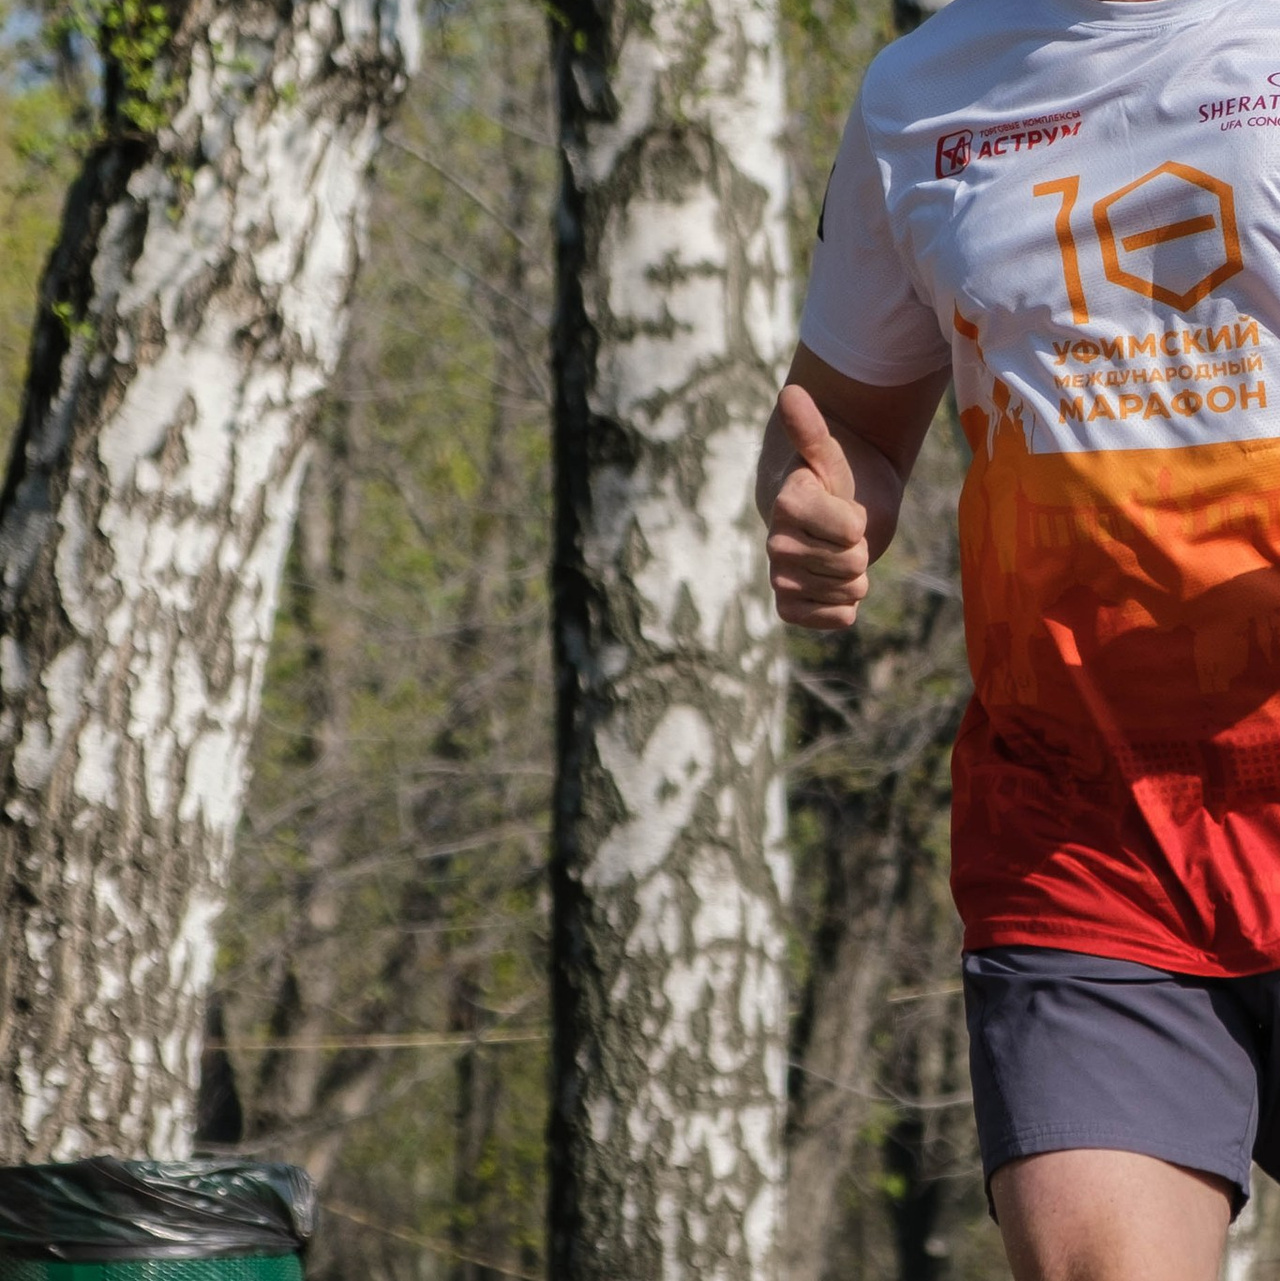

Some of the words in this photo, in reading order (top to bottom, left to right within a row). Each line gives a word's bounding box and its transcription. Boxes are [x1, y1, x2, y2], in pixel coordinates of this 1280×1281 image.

[977, 122, 1082, 159] АСТРУМ
[980, 121, 1020, 137] ТОРГОВЫЕ
[1022, 110, 1081, 129] КОМПЛЕКСЫ
[1220, 119, 1242, 131] UFA
[1051, 315, 1260, 366] УФИМСКИЙ
[1053, 352, 1263, 390] МЕЖДУНАРОДНЫЙ
[1057, 381, 1268, 424] МАРАФОН
